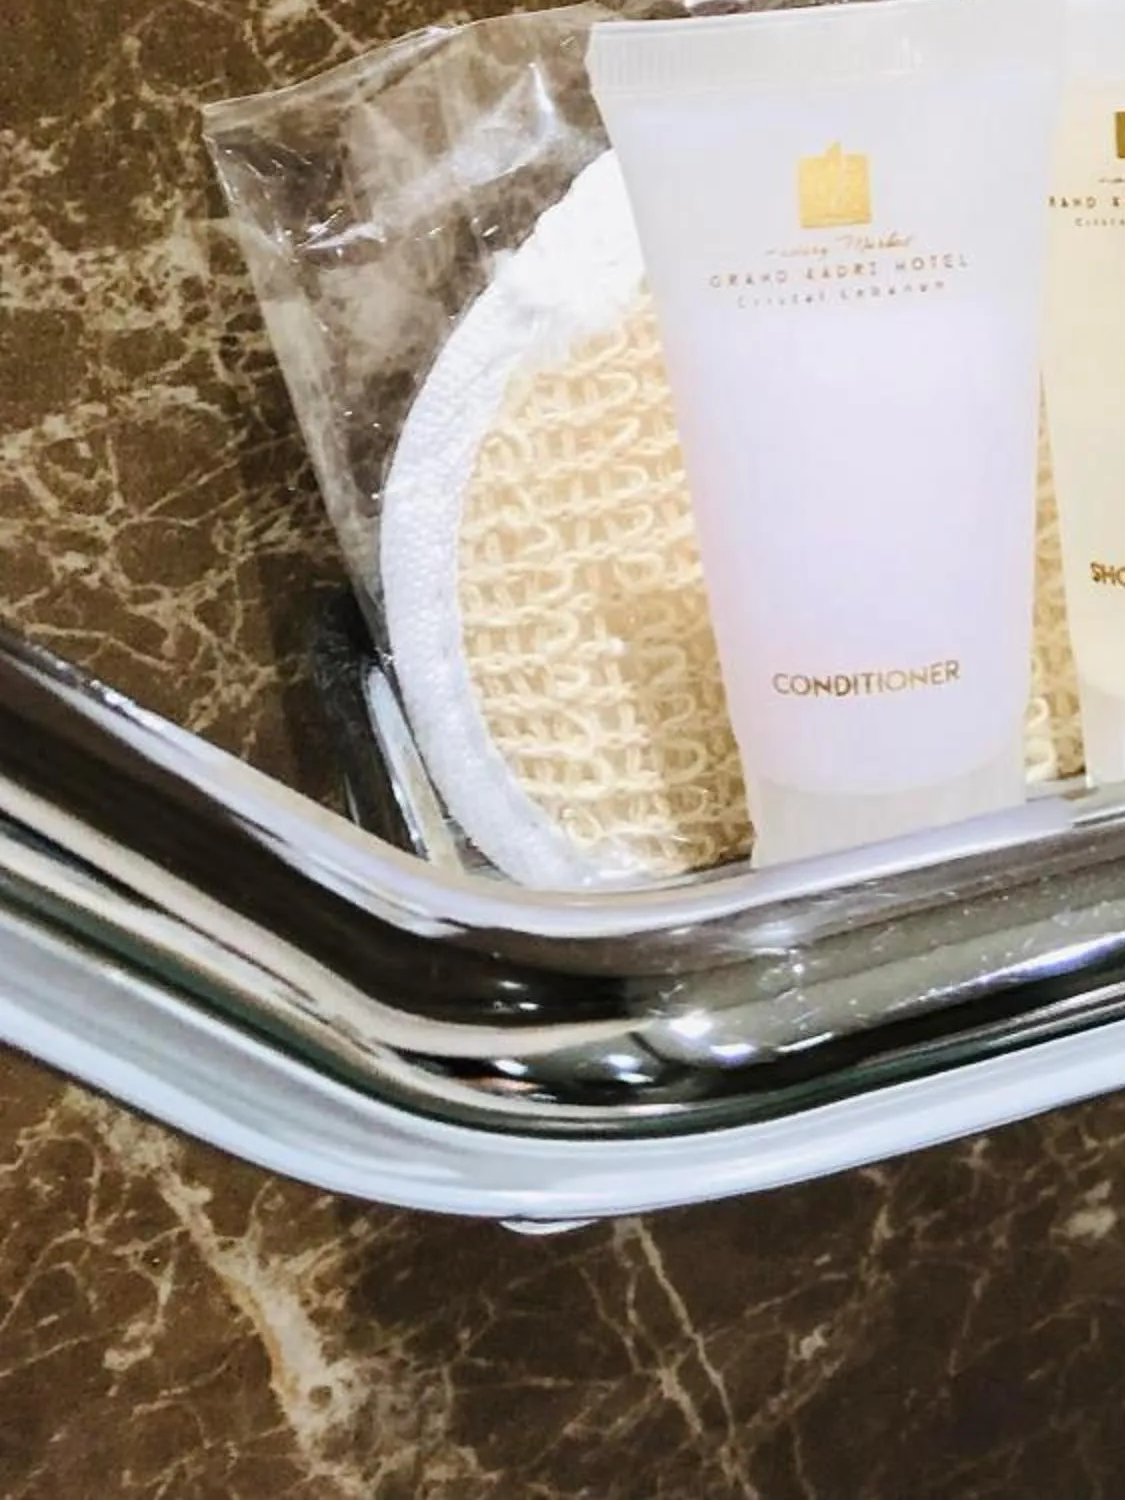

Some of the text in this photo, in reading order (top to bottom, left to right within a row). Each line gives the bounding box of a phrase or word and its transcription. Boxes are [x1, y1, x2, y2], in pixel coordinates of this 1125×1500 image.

[709, 269, 789, 289] GRAND
[895, 253, 969, 273] HOTEL
[772, 659, 961, 697] CONDITIONER
